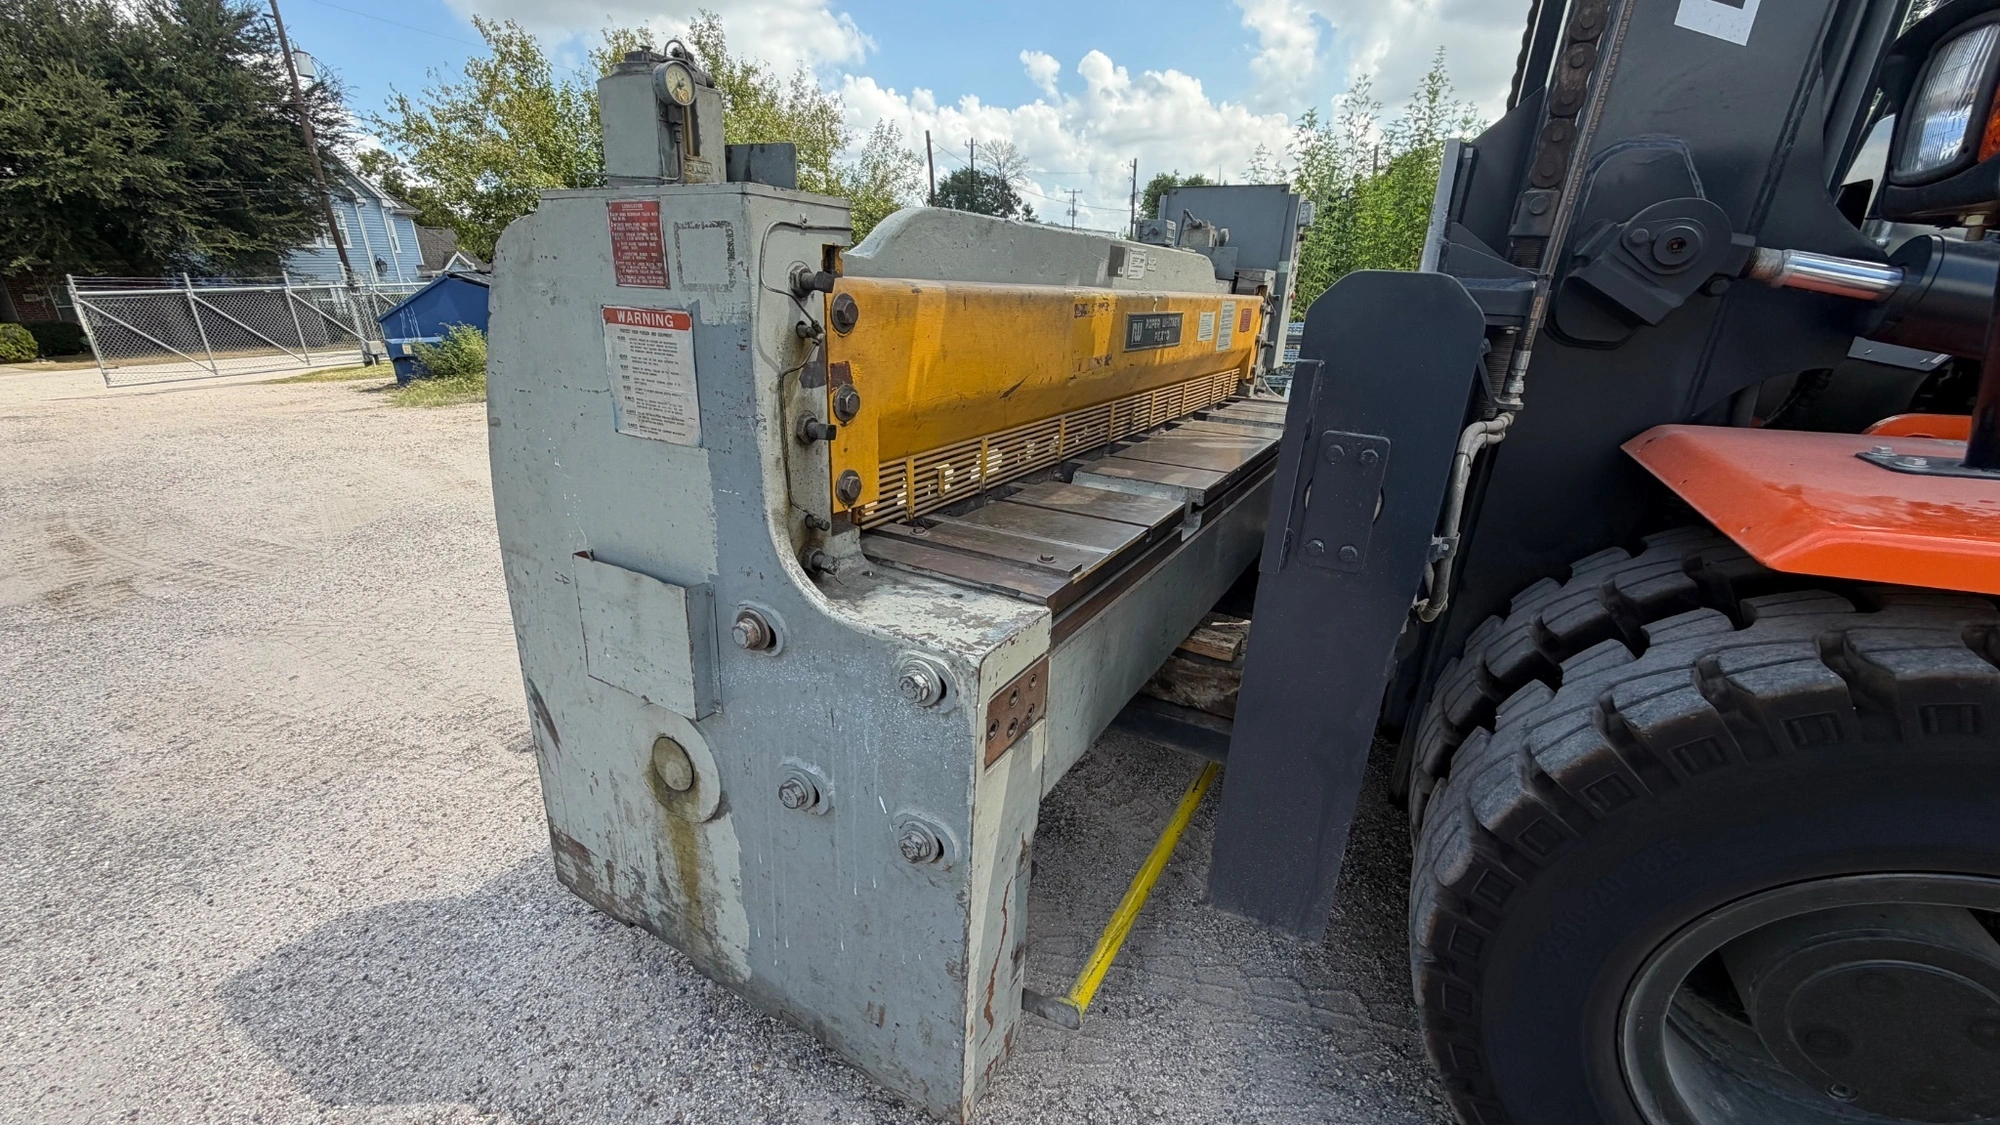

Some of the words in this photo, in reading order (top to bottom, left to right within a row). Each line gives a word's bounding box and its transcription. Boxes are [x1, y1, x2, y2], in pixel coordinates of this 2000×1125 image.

[616, 310, 674, 328] WARNING
[1145, 318, 1160, 329] ROPER
[1154, 330, 1170, 342] PEXTO
